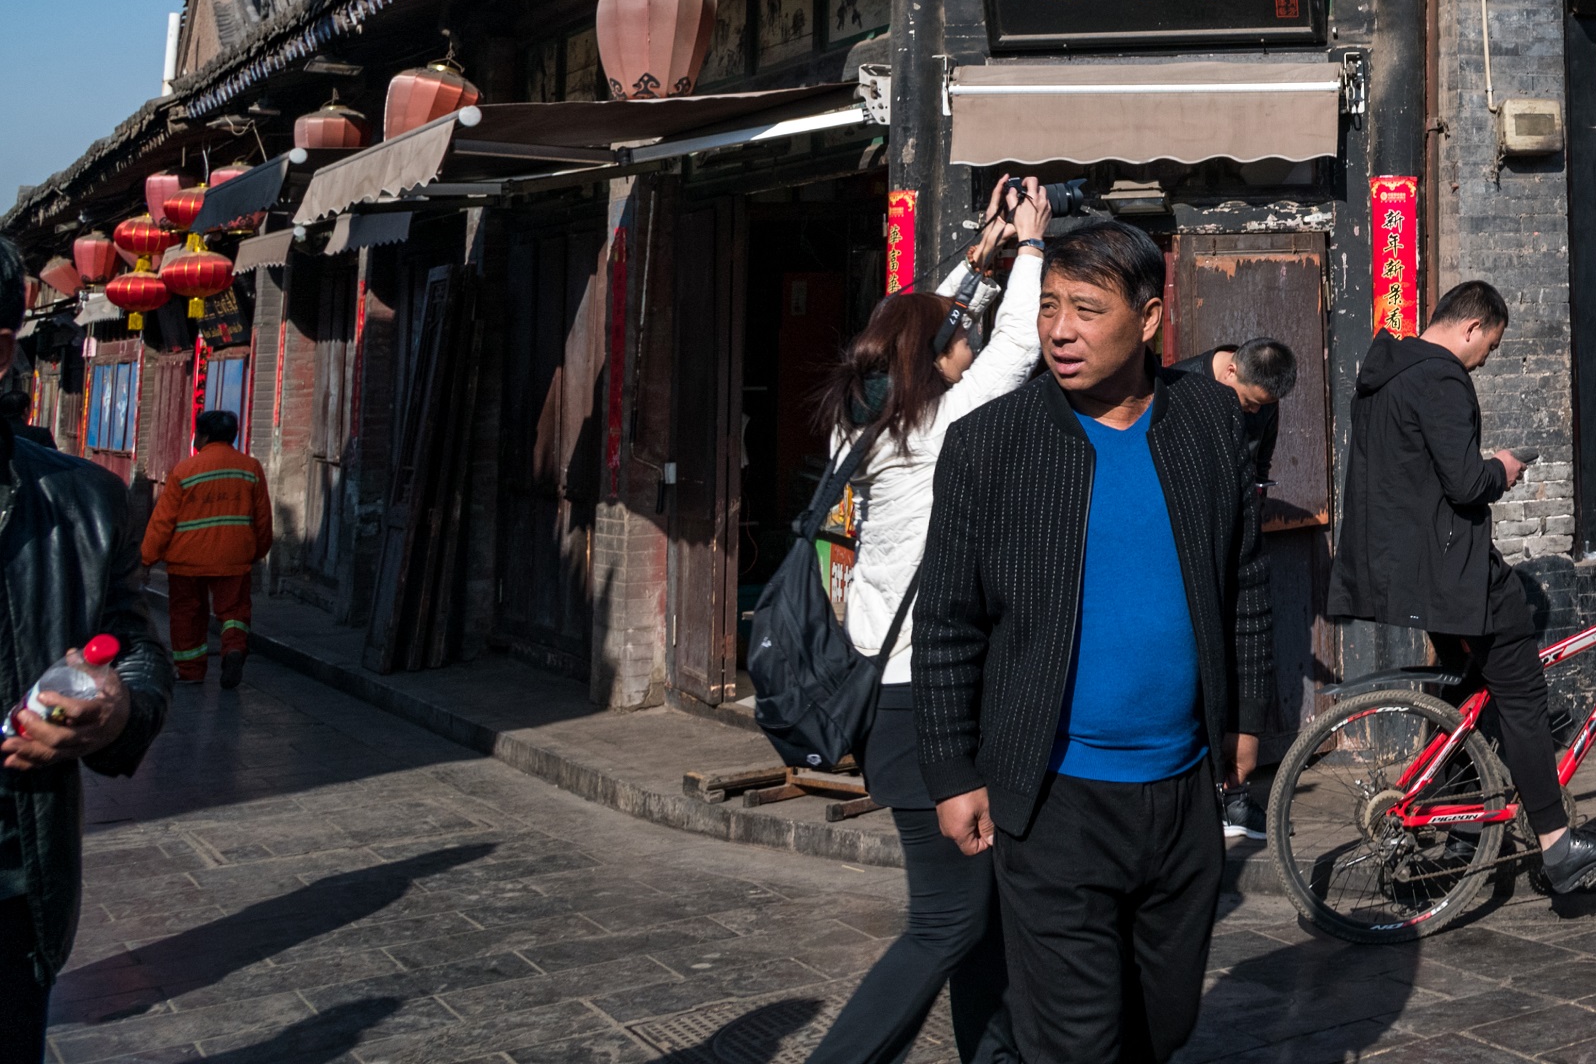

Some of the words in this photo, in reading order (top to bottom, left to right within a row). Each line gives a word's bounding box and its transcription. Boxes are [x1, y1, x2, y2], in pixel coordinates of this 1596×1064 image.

[1381, 209, 1405, 340] 新年新景看
[1431, 813, 1479, 824] PIGEON
